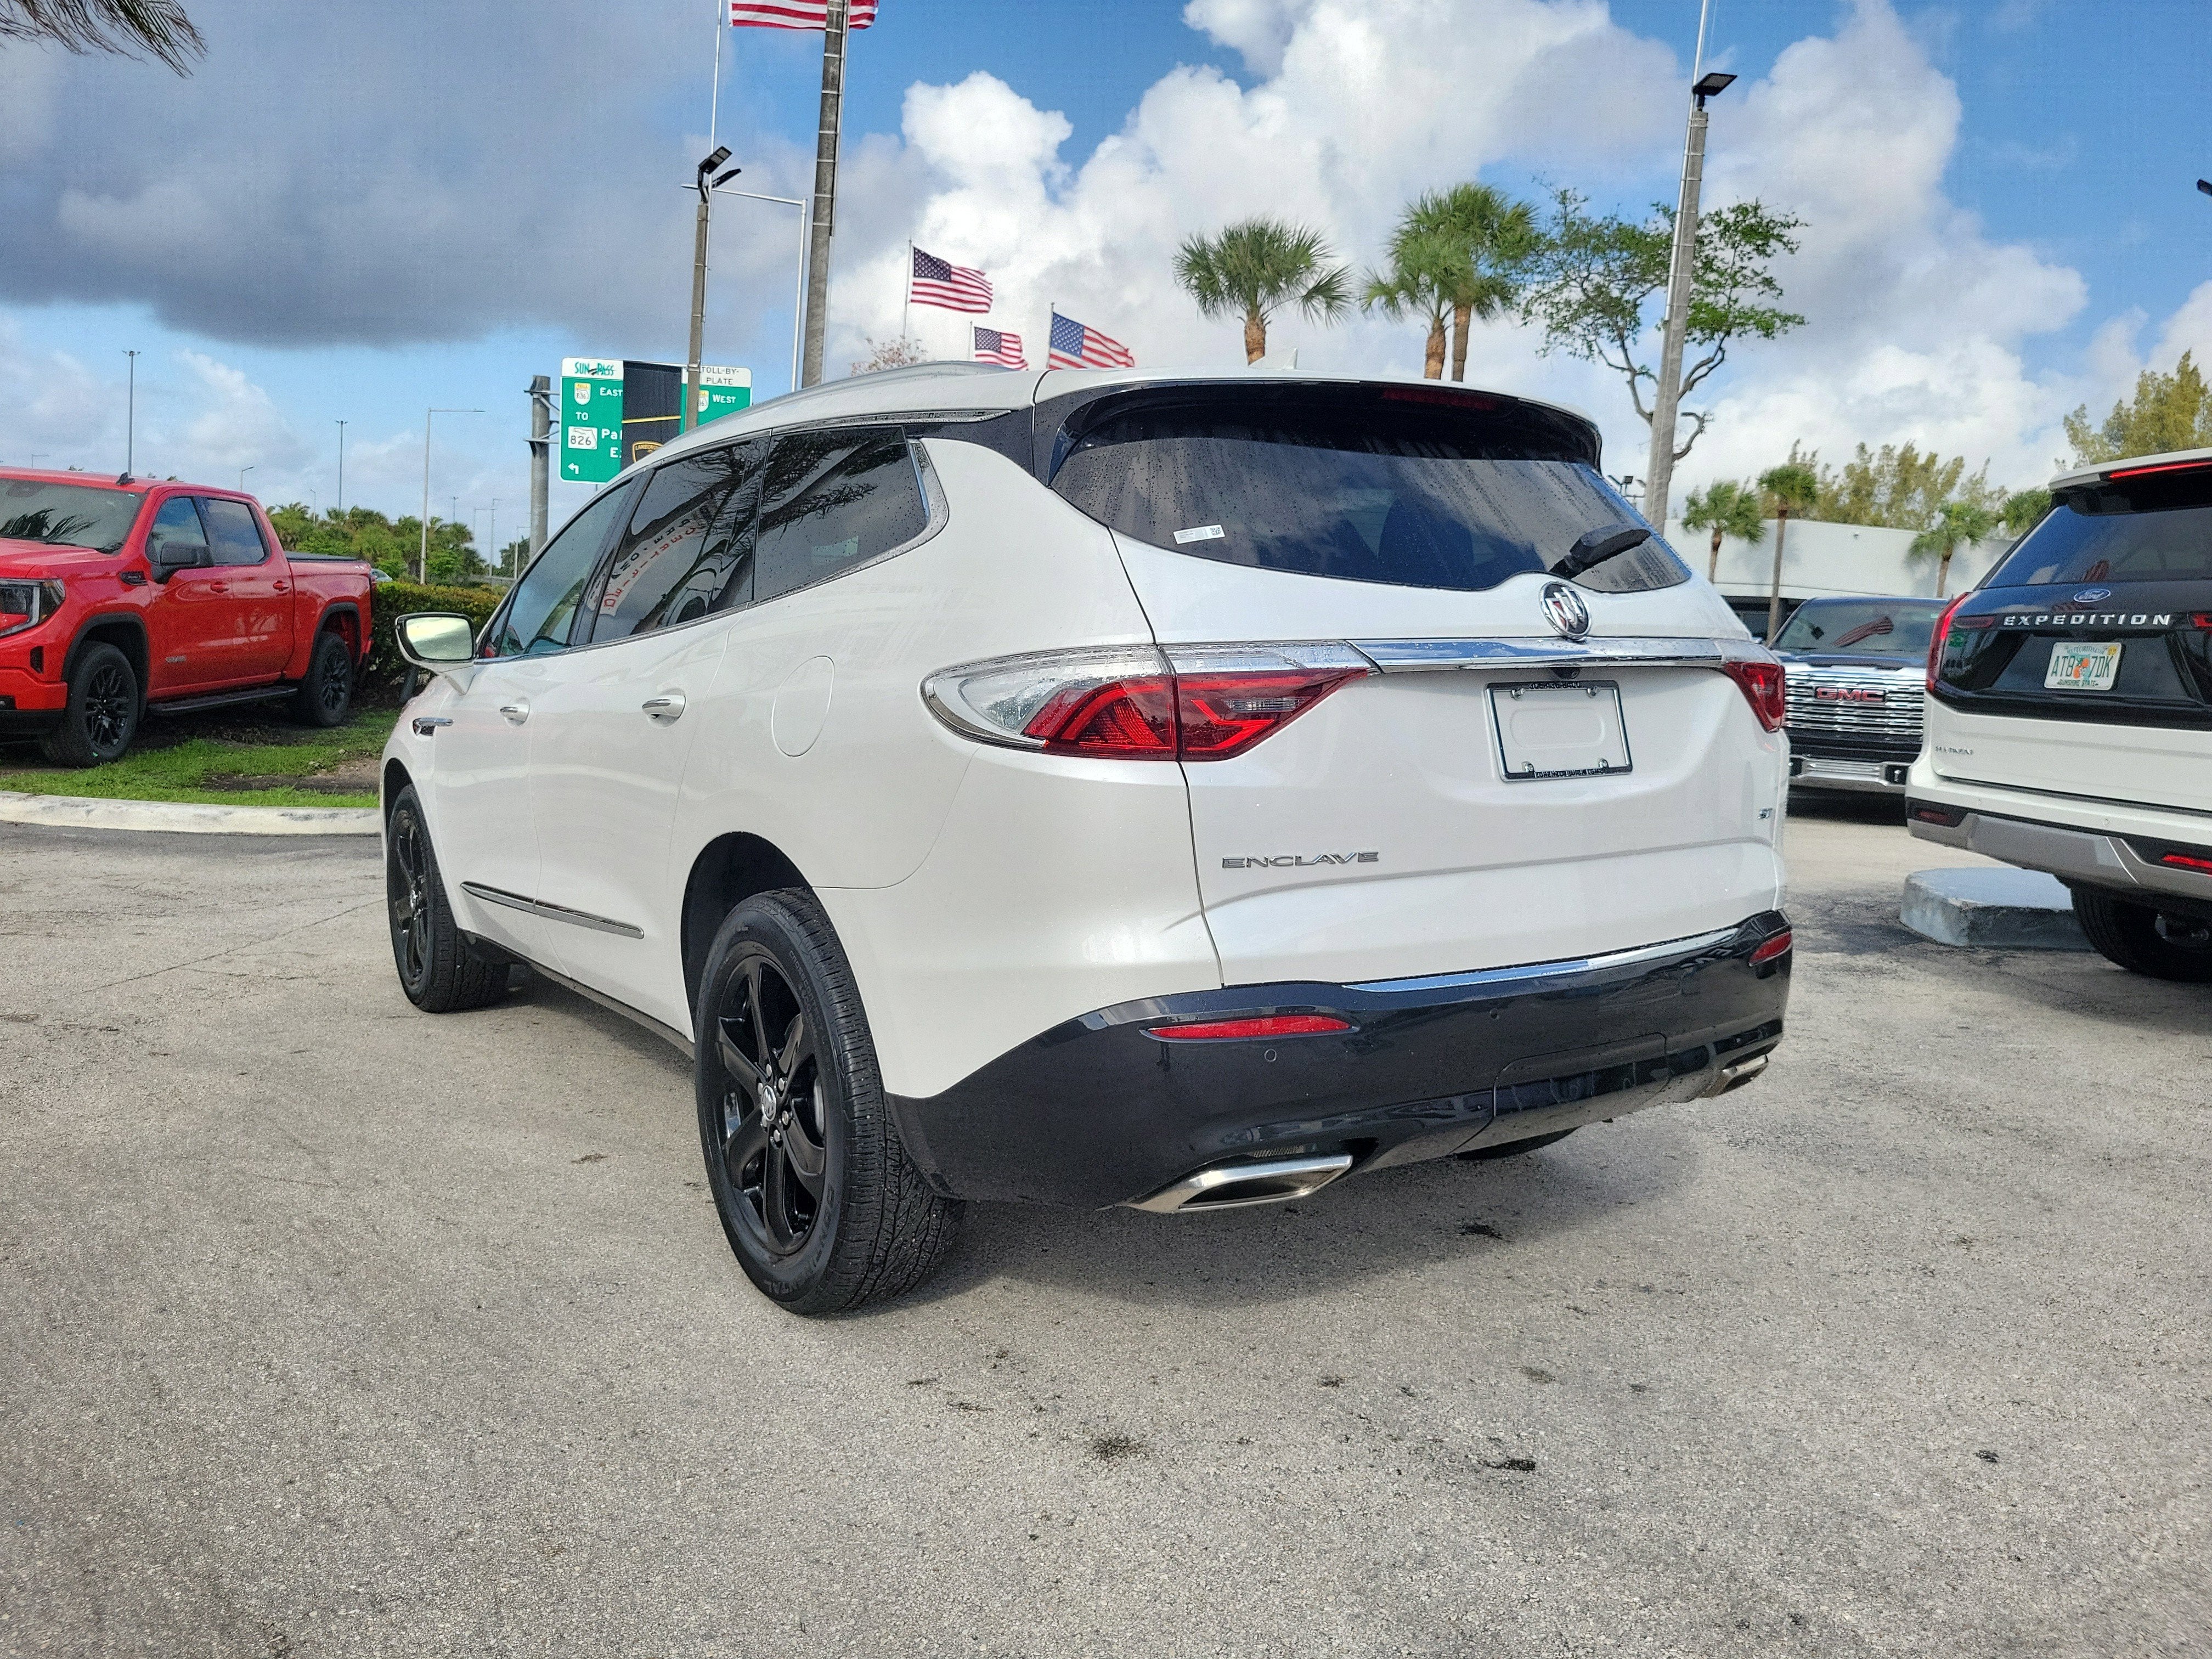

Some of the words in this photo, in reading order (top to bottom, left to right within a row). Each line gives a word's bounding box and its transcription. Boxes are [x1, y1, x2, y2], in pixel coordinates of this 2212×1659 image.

[706, 377, 733, 385] PLATE
[600, 387, 623, 397] EAST
[712, 394, 736, 404] WEST
[575, 411, 589, 421] TO
[570, 435, 592, 445] 826
[2003, 613, 2171, 627] EXPEDITION
[1816, 687, 1884, 702] GMC
[1222, 851, 1379, 868] ENCLAVE
